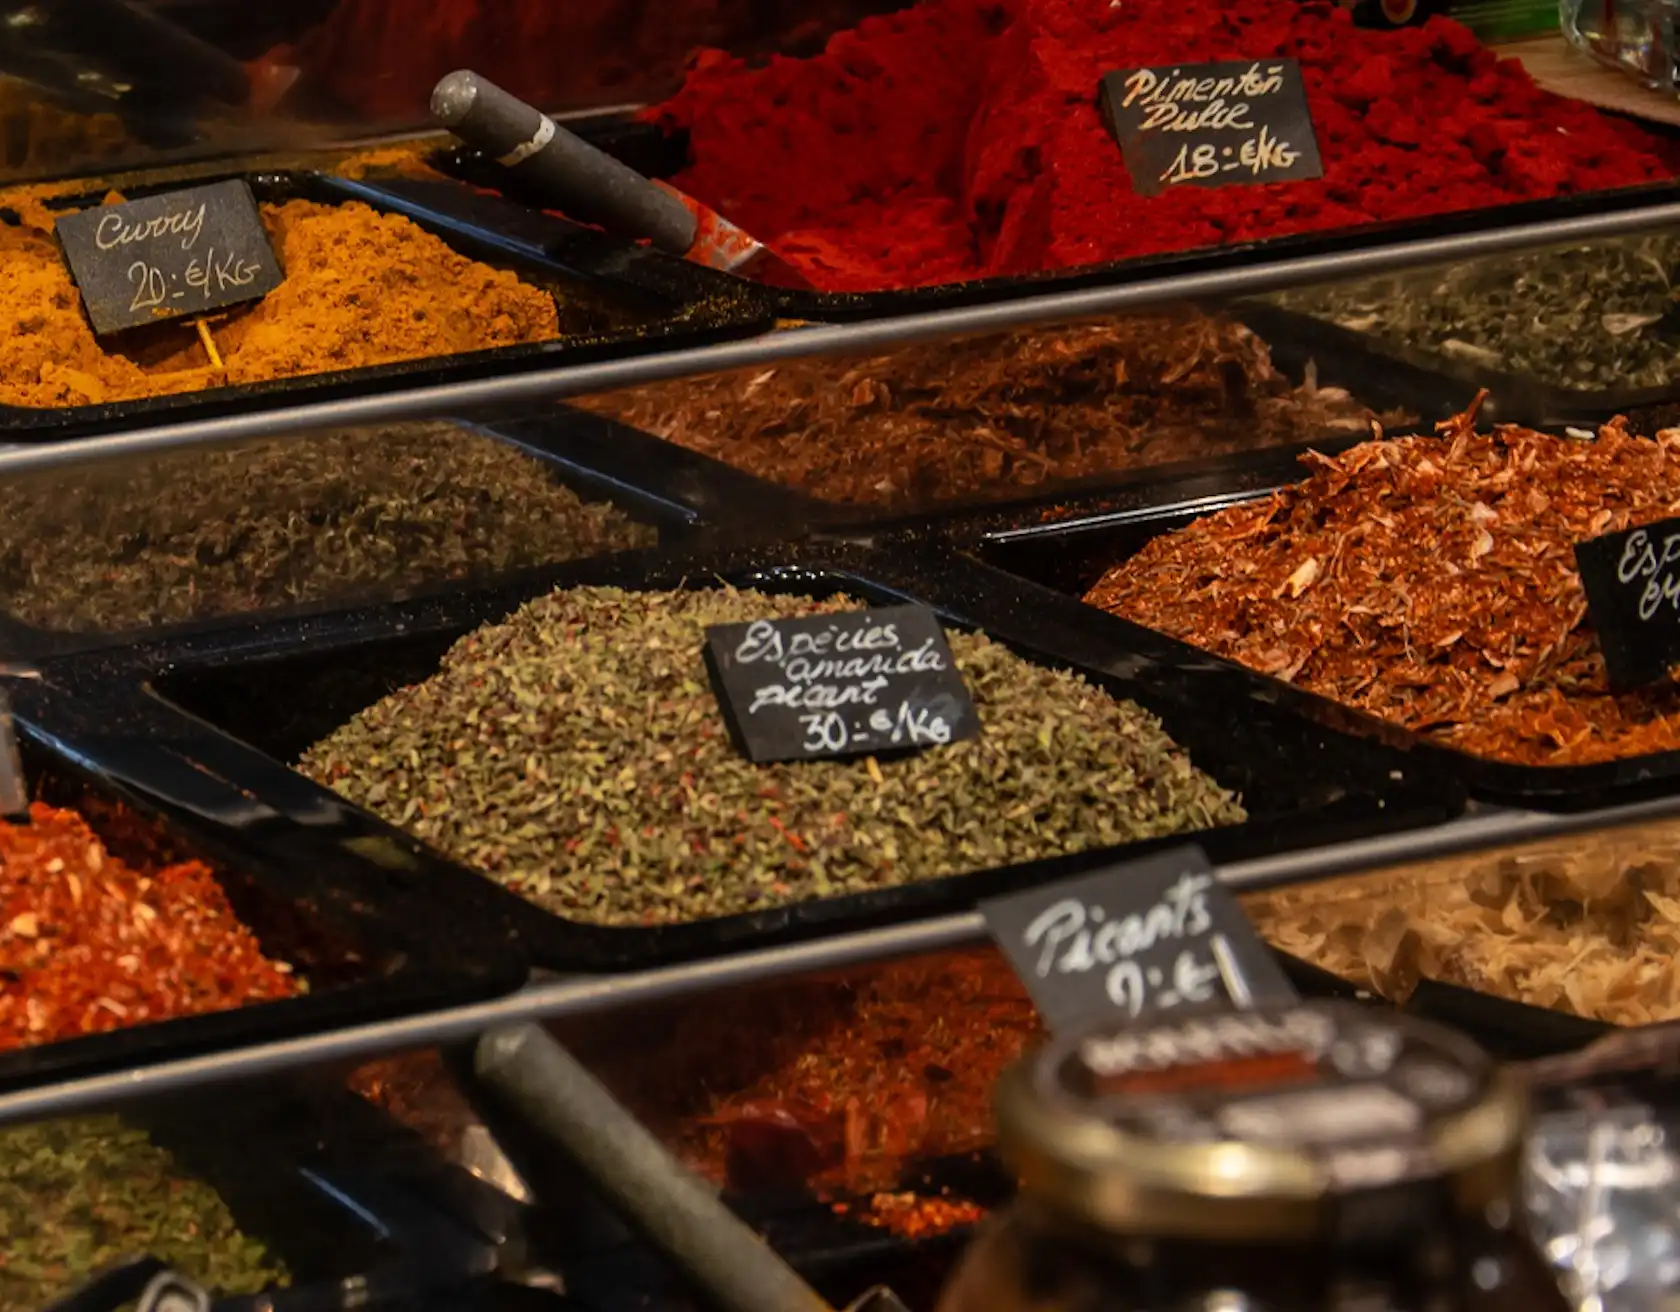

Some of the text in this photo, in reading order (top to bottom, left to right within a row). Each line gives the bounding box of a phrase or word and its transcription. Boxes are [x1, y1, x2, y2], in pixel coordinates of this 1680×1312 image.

[1138, 98, 1254, 131] Dulce
[95, 203, 206, 250] Curry
[1024, 872, 1214, 979] Picants
